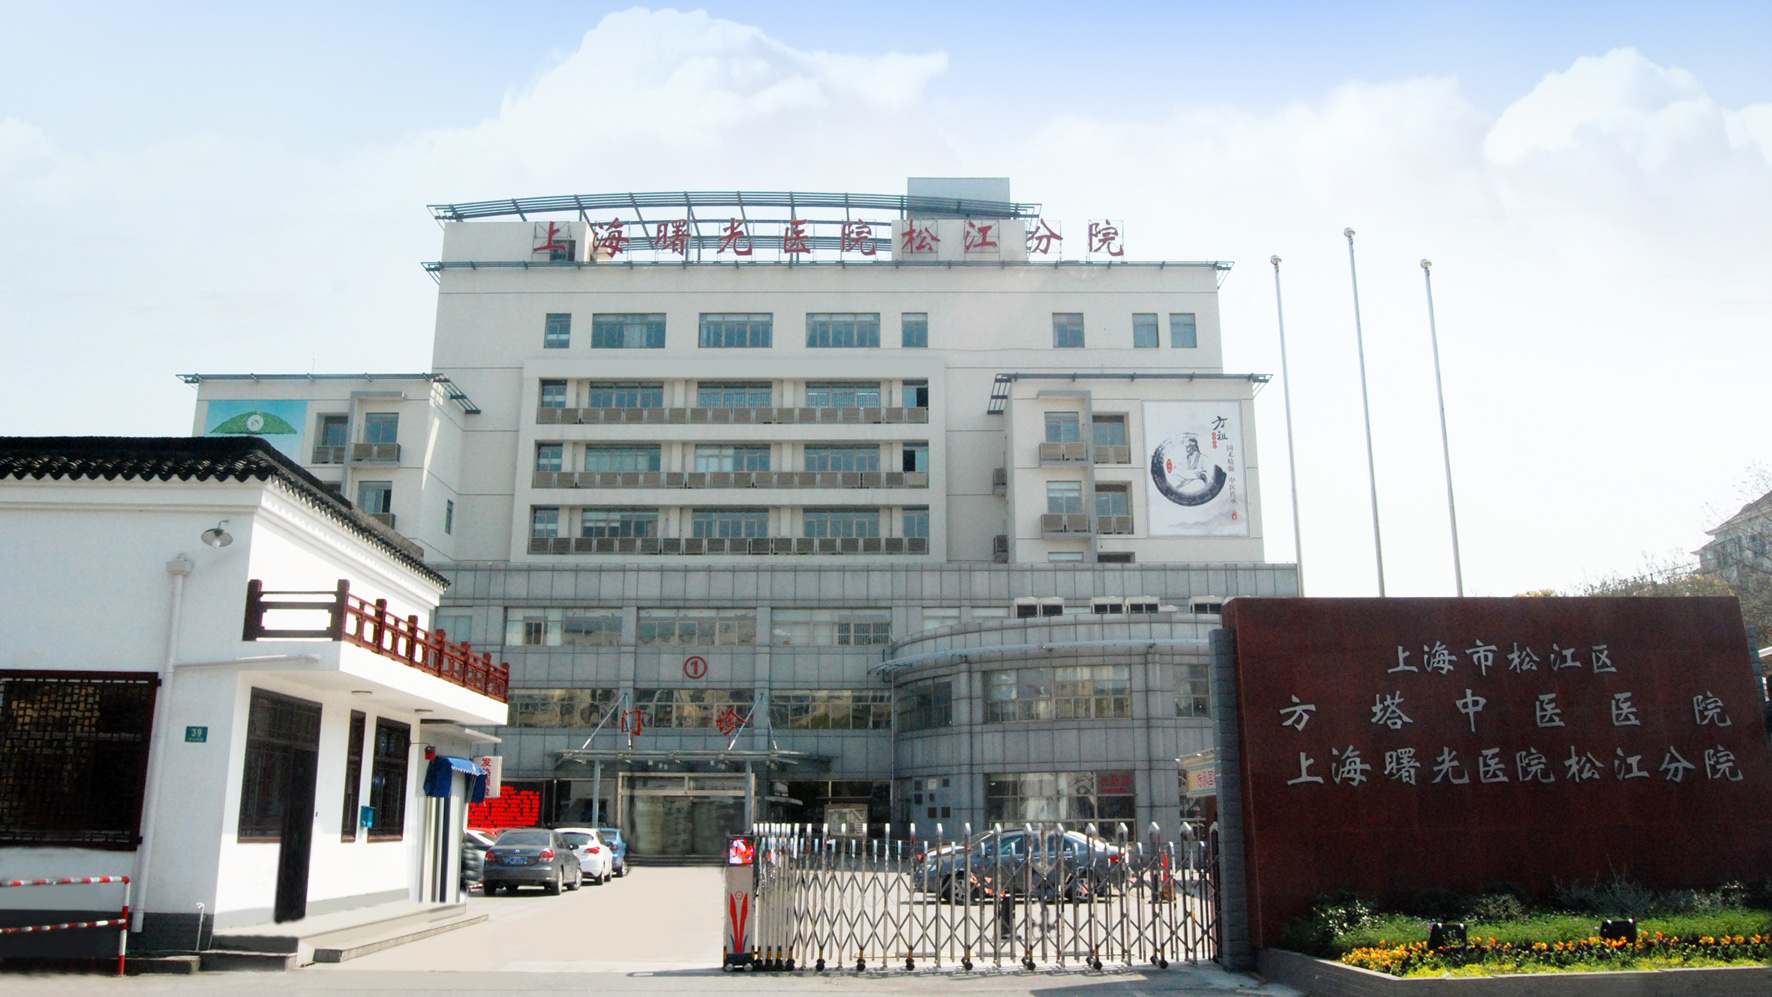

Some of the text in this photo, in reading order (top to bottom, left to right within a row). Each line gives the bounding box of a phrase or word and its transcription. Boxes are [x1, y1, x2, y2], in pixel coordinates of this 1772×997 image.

[532, 217, 1125, 257] 上海曙光医院松江分院
[1386, 639, 1618, 677] 上海市松江区
[621, 707, 746, 736] 门诊
[1279, 688, 1732, 733] 方塔中医医院
[191, 728, 202, 737] 39
[1286, 743, 1744, 787] 上海曙光医院松江分院
